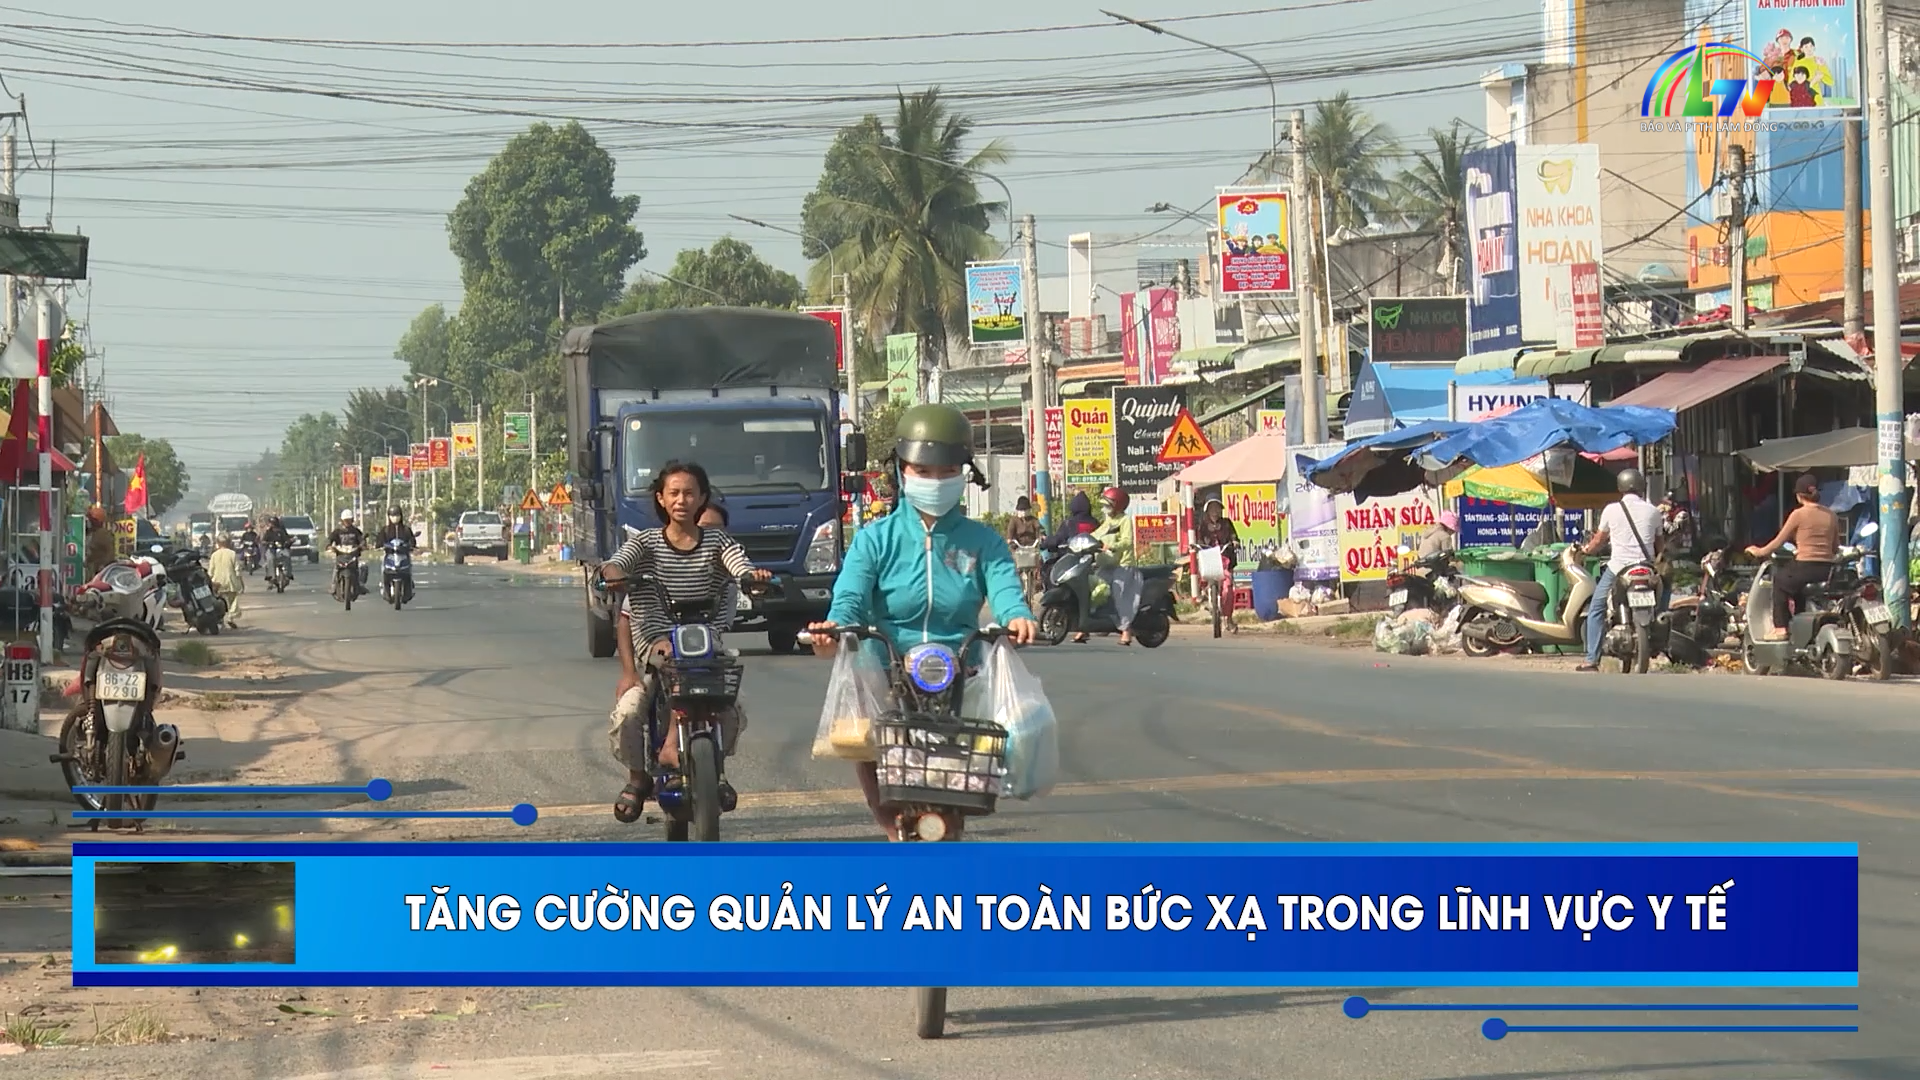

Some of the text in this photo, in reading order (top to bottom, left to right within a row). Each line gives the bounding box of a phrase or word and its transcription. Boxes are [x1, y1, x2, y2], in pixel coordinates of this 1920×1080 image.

[1526, 205, 1594, 227] NHA KHOA
[1527, 236, 1593, 264] HOÀN
[1410, 311, 1431, 326] NHA
[1071, 407, 1108, 428] Quán
[1121, 395, 1181, 425] Quỳnh
[1127, 445, 1144, 455] Nail
[1121, 463, 1139, 474] Trang
[1227, 490, 1276, 526] Mì Quảng
[1346, 498, 1435, 534] NHẬN SỬA
[1501, 528, 1524, 536] YAMHA
[7, 663, 33, 681] H8
[10, 690, 31, 703] 17
[103, 686, 138, 698] 0290
